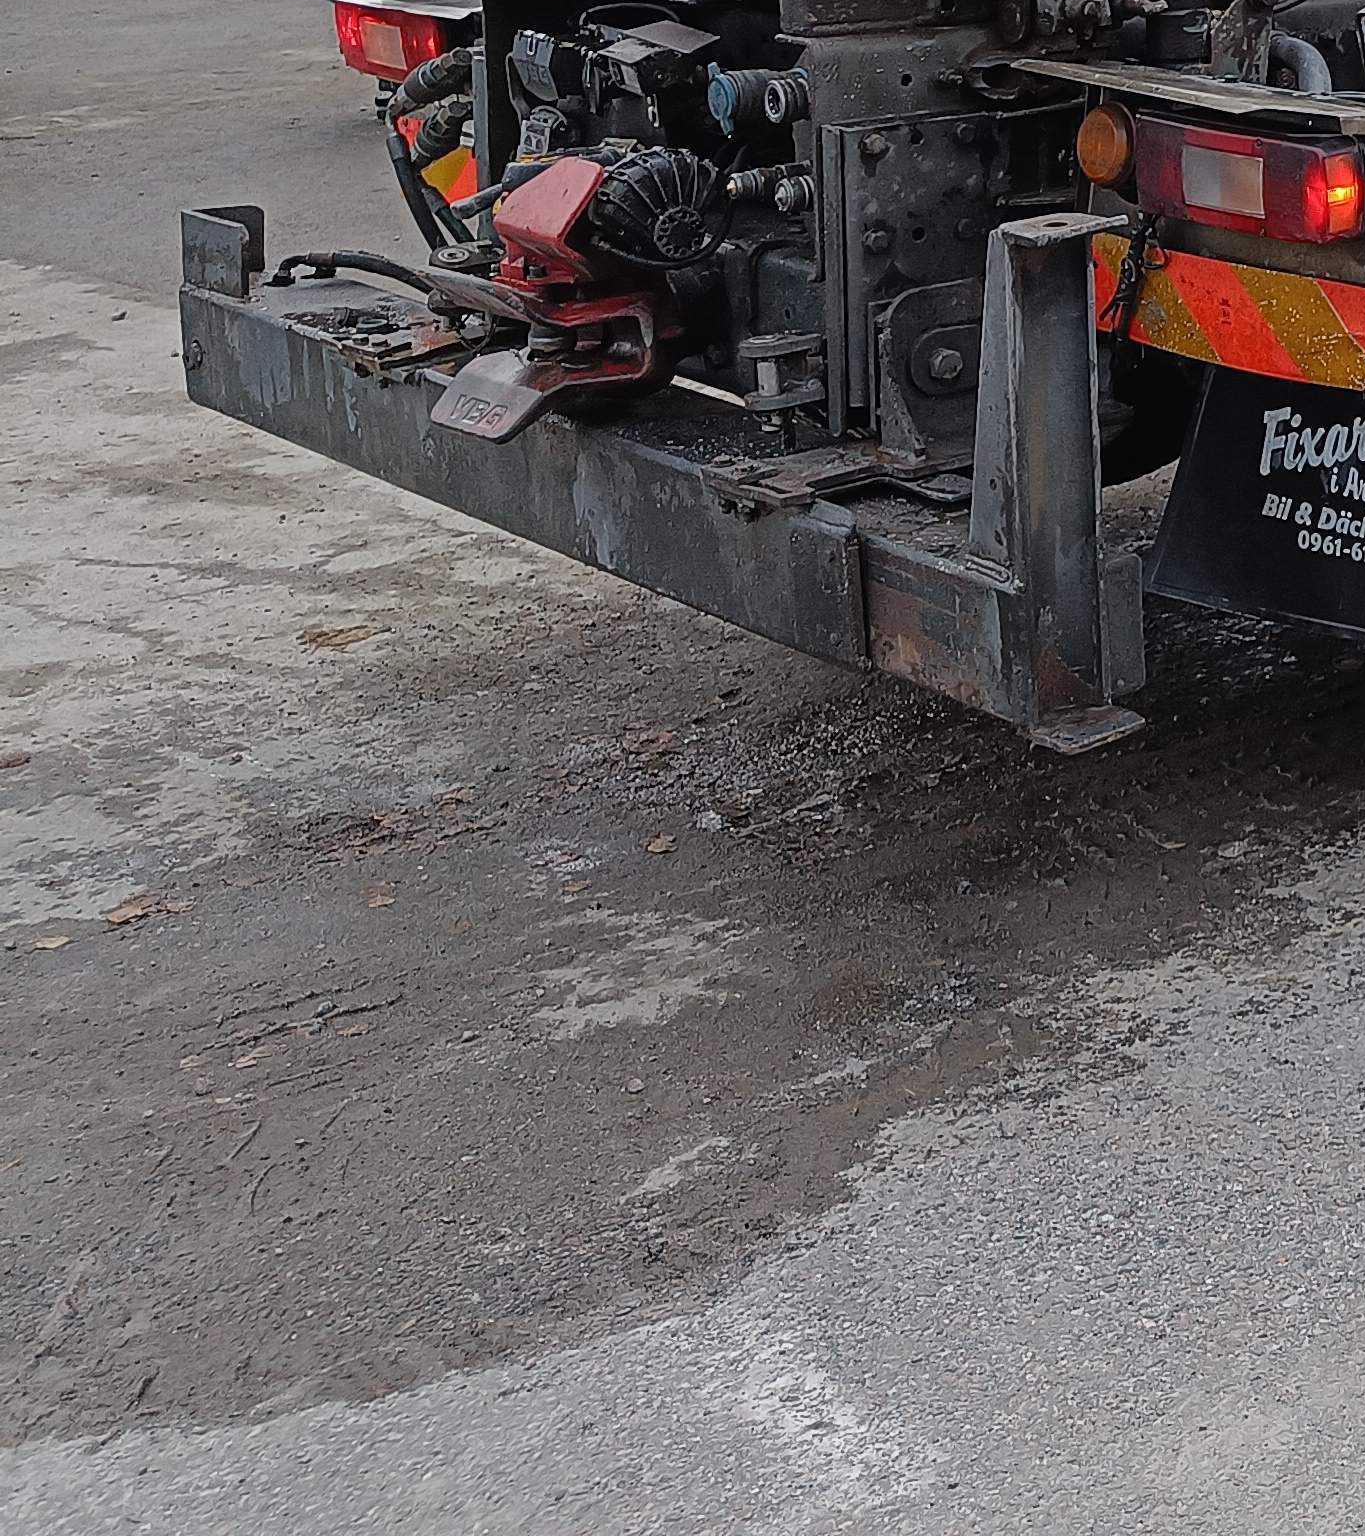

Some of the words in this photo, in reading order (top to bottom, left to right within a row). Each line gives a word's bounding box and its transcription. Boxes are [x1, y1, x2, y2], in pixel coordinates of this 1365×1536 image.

[450, 393, 508, 430] VBG
[1330, 467, 1338, 493] i
[1262, 493, 1292, 520] Bil
[1294, 501, 1312, 526] &
